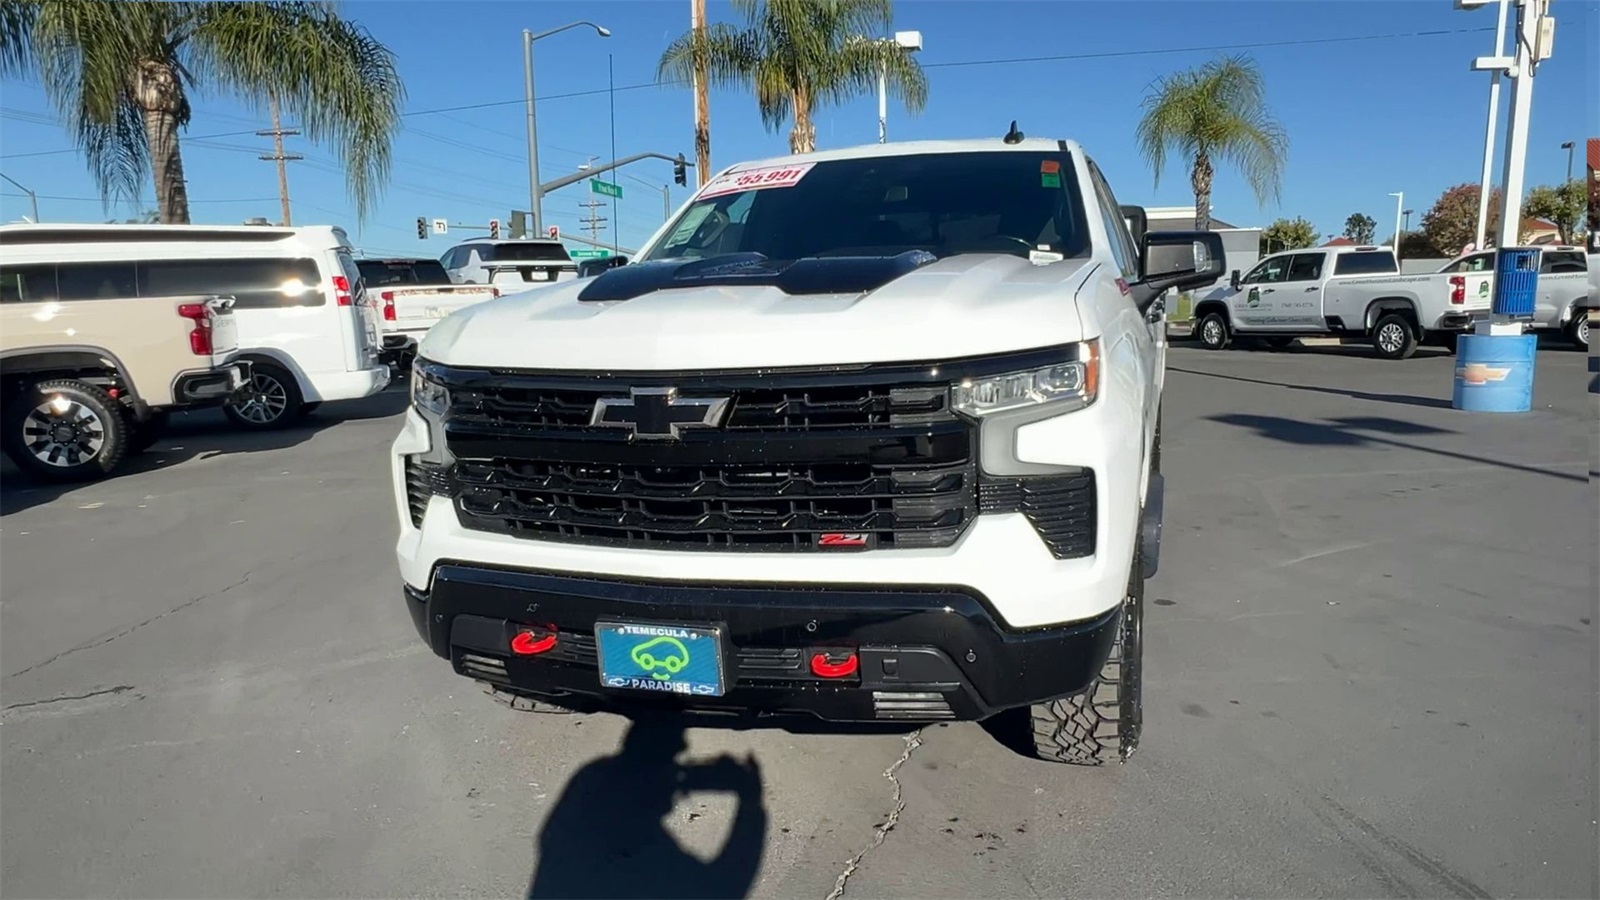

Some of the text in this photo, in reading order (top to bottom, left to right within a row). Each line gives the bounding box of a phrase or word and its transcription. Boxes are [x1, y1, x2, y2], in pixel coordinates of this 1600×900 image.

[818, 533, 869, 545] Z71
[624, 626, 689, 638] TEMECULA
[631, 679, 692, 693] PARADISE
